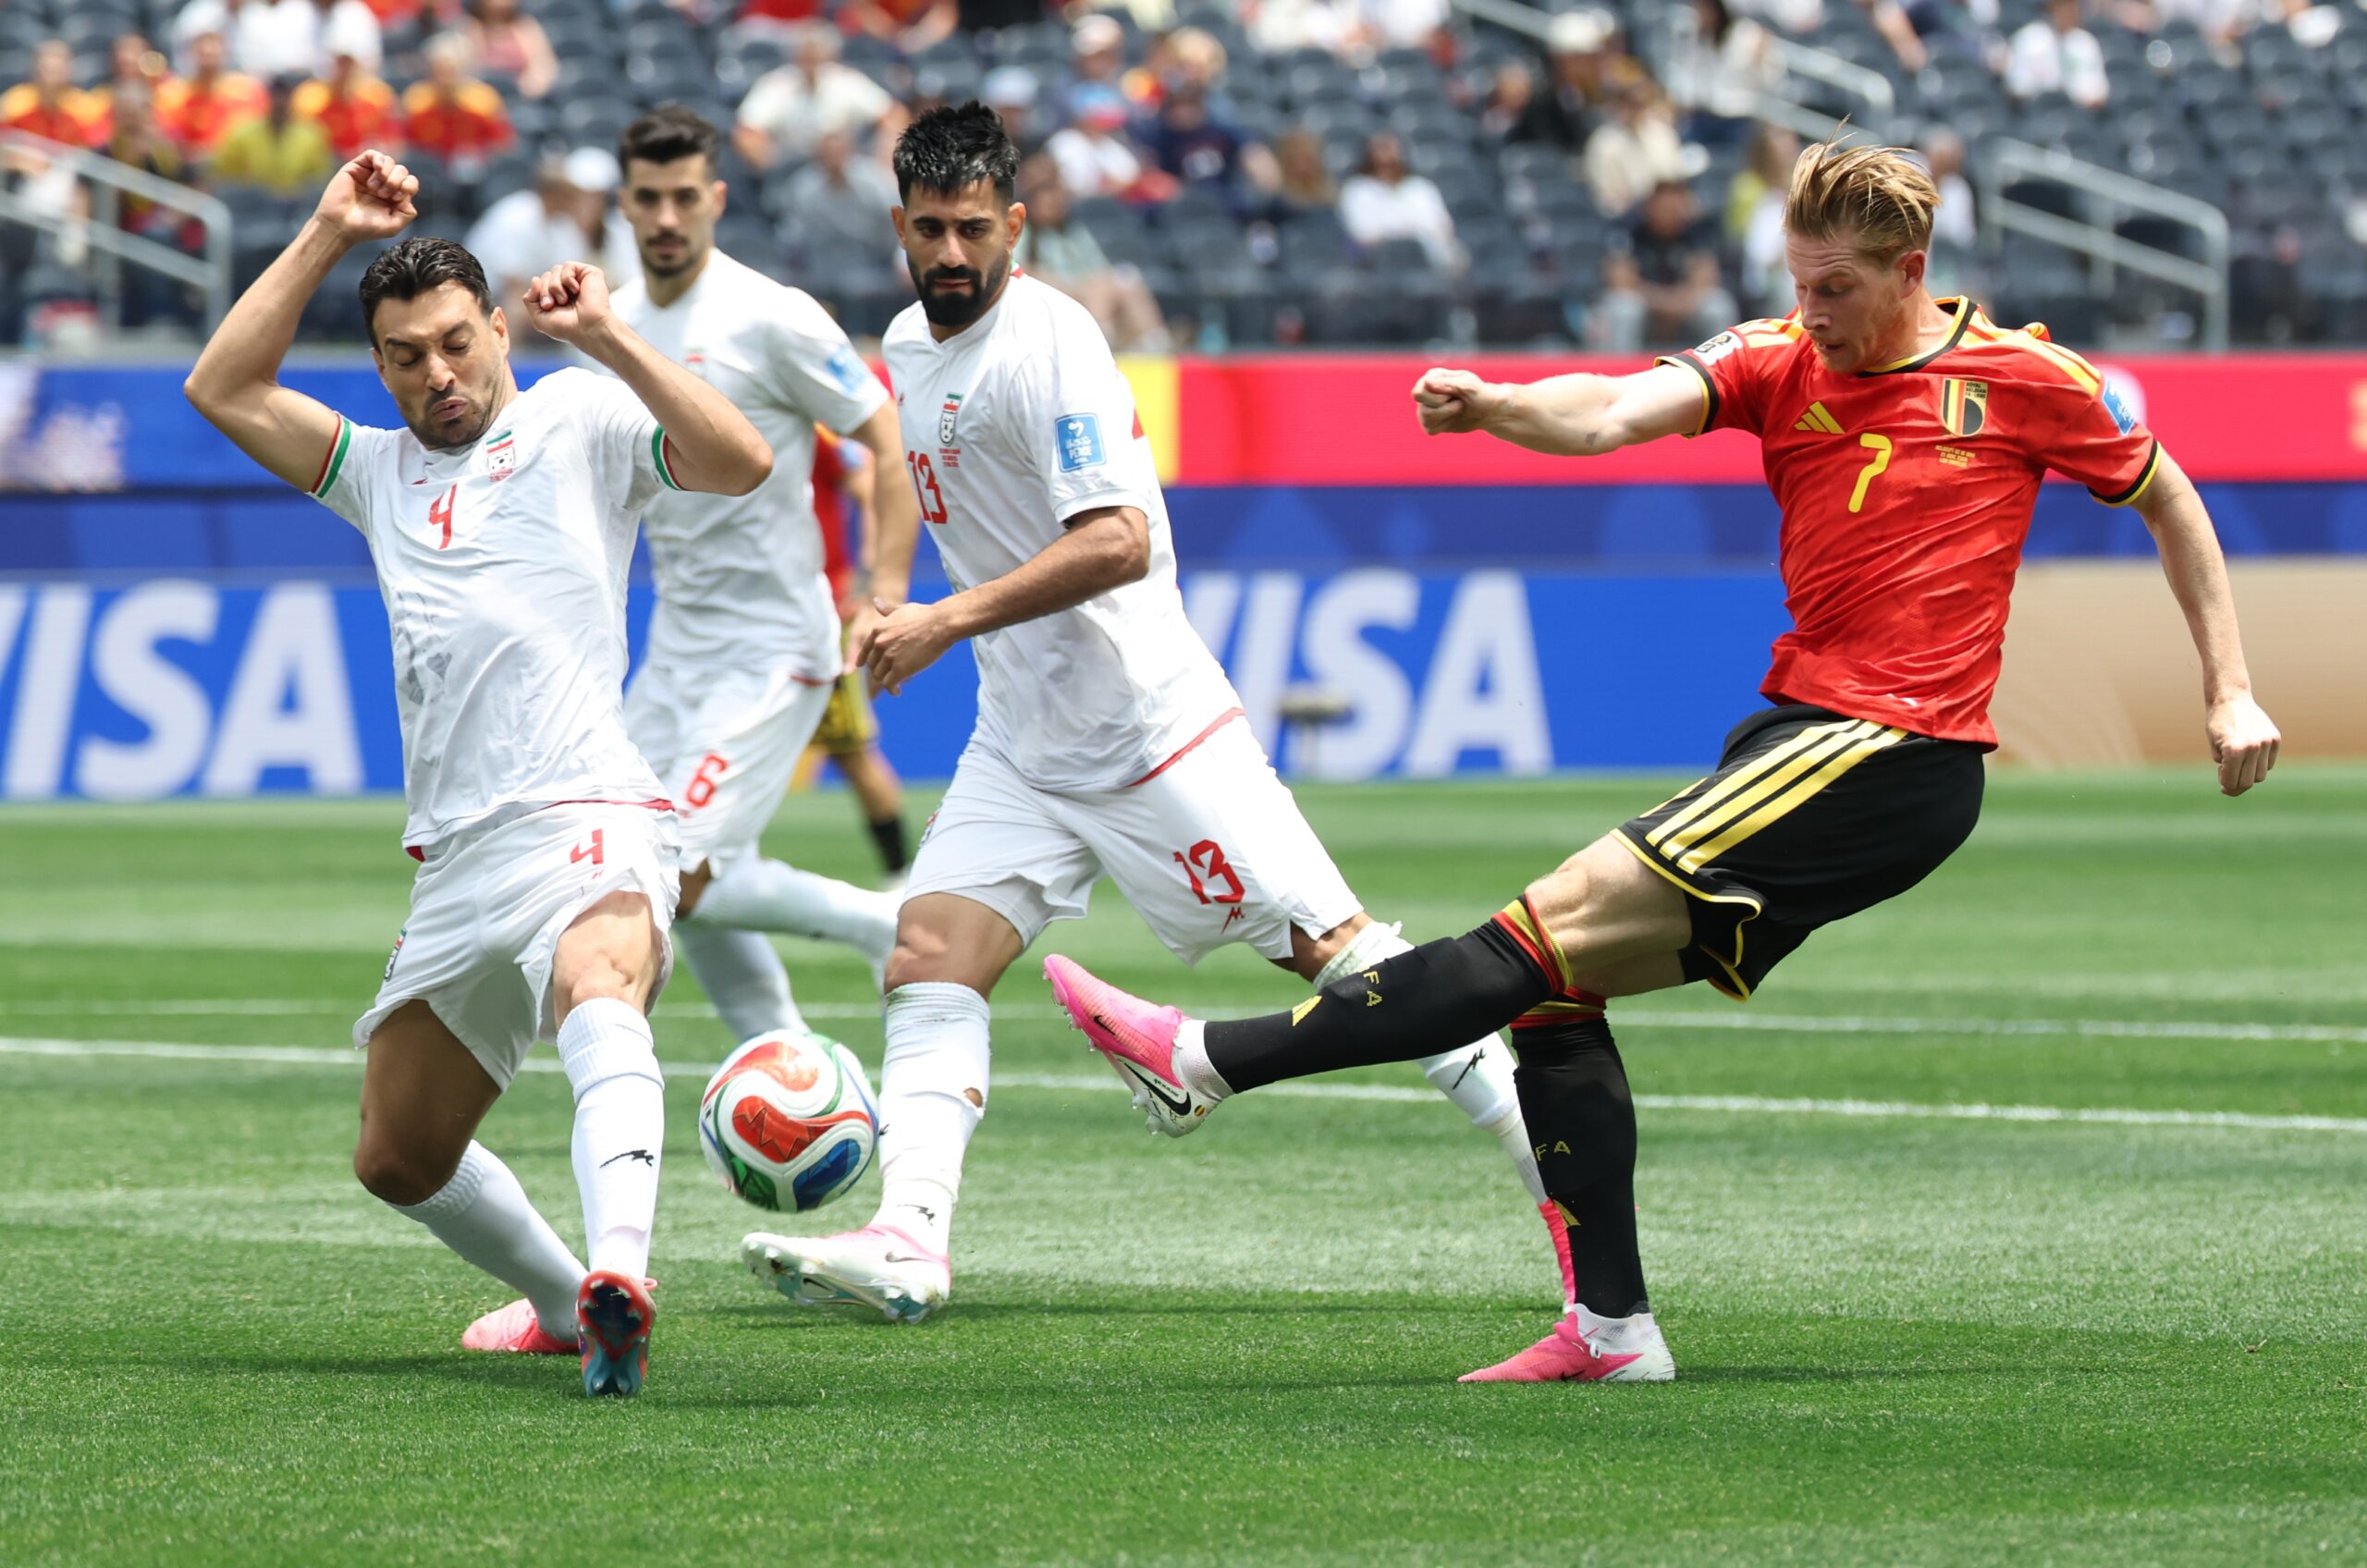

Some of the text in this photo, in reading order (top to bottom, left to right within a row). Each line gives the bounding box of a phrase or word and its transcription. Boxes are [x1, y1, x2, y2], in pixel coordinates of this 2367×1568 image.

[908, 450, 948, 524] 13
[1848, 433, 1893, 513] 7
[429, 483, 458, 550] 4
[0, 579, 366, 802] ISA
[686, 753, 729, 809] 6
[570, 828, 604, 864] 4
[1172, 839, 1245, 905] 13
